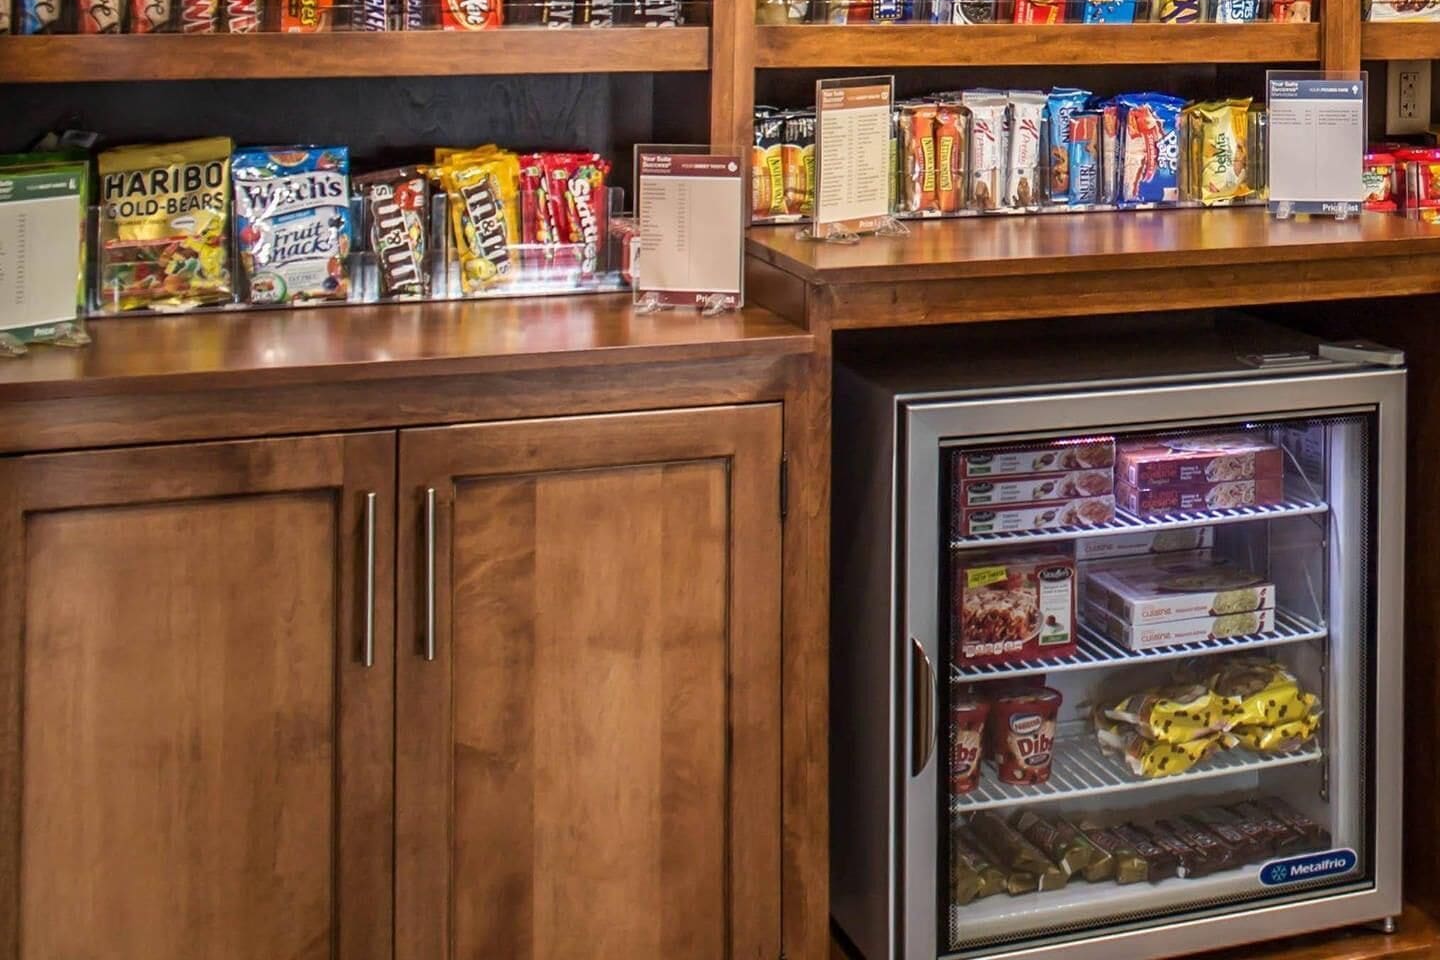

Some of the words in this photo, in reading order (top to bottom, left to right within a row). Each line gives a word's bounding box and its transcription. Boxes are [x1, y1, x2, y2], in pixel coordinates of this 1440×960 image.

[104, 161, 225, 202] HARIBO
[106, 191, 224, 220] GOLD-BEARS
[273, 220, 323, 248] Fruit
[567, 178, 599, 276] Skittles
[1017, 737, 1055, 756] Dibs
[1290, 856, 1347, 878] Metalfrio
